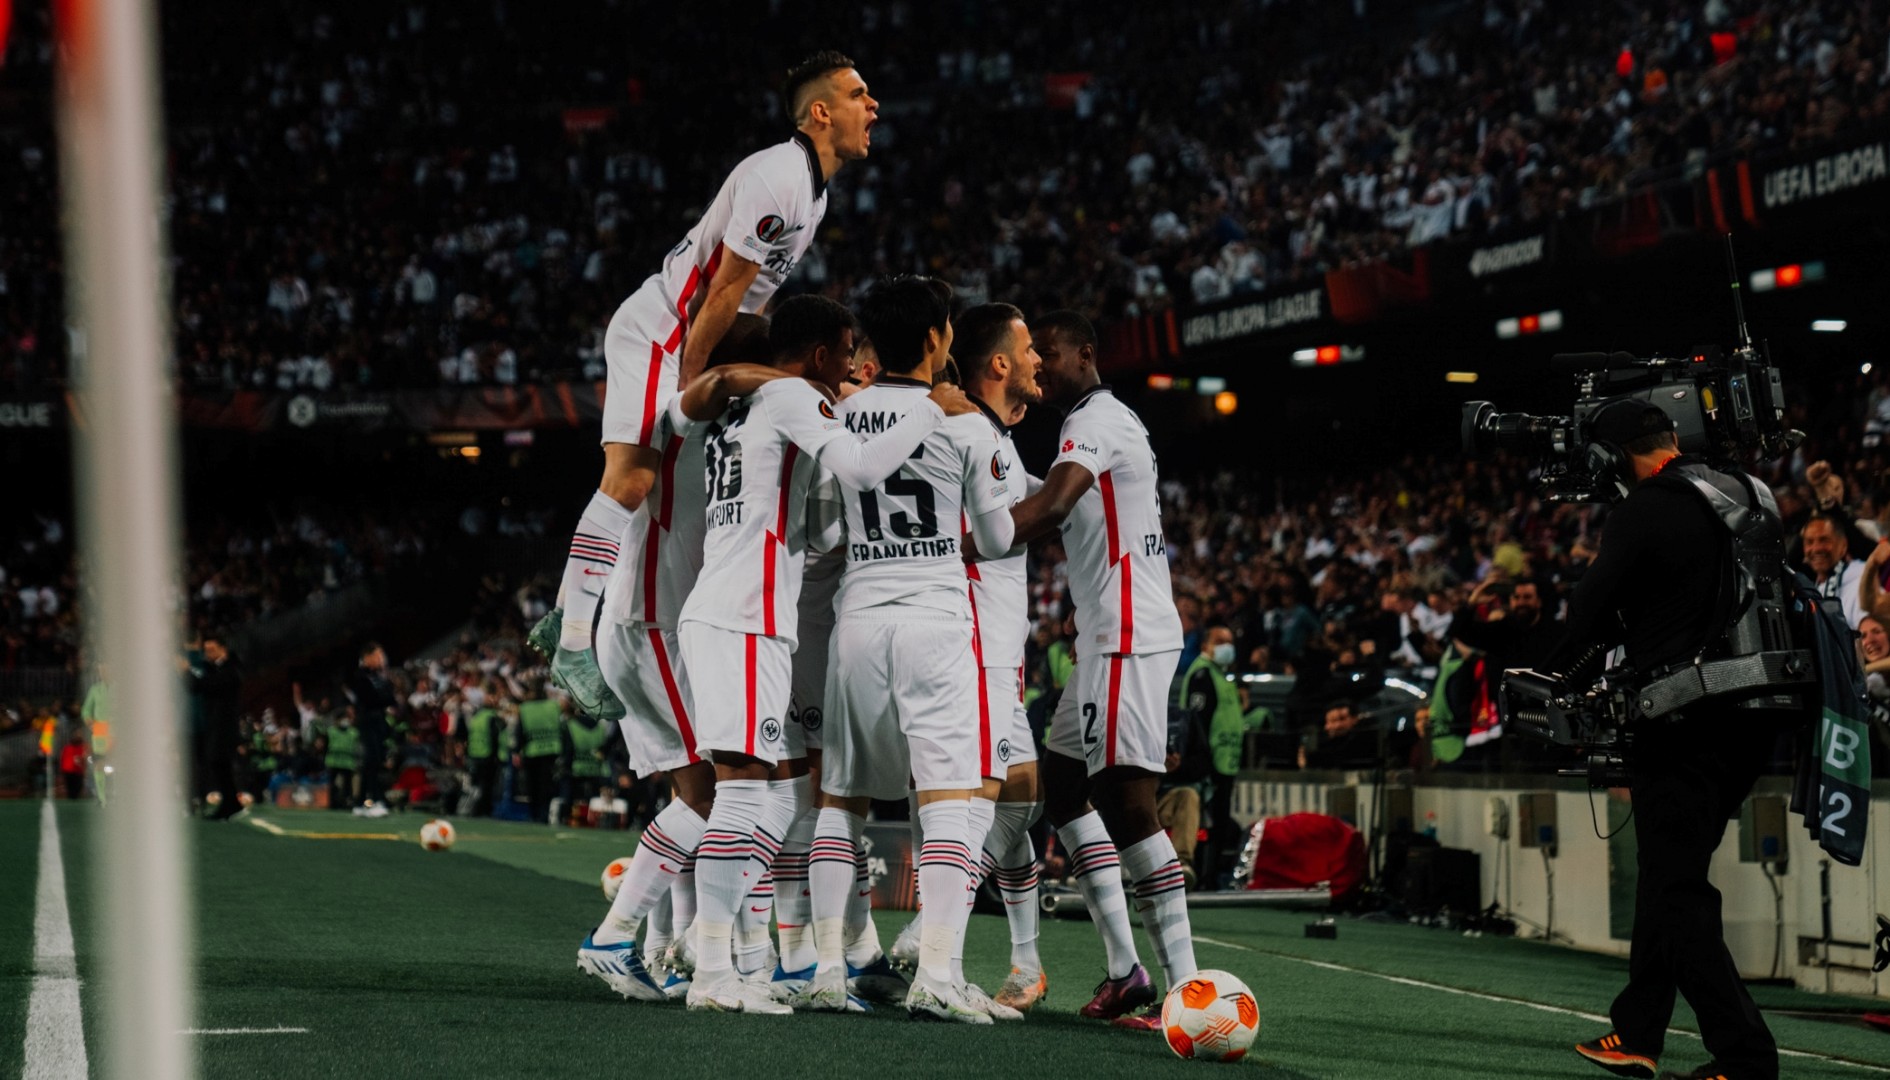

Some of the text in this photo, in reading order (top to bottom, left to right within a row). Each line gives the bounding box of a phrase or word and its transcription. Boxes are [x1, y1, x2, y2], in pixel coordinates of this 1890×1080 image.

[1764, 143, 1886, 207] UEFA EUROPA
[1216, 303, 1266, 339] EUROPA
[1268, 289, 1322, 329] LEAGUE
[845, 411, 906, 434] KAMA
[1077, 443, 1098, 455] dpd
[858, 443, 939, 542] 15
[852, 537, 957, 562] FRANKFURT
[1083, 703, 1097, 744] 2
[1820, 784, 1852, 837] 2
